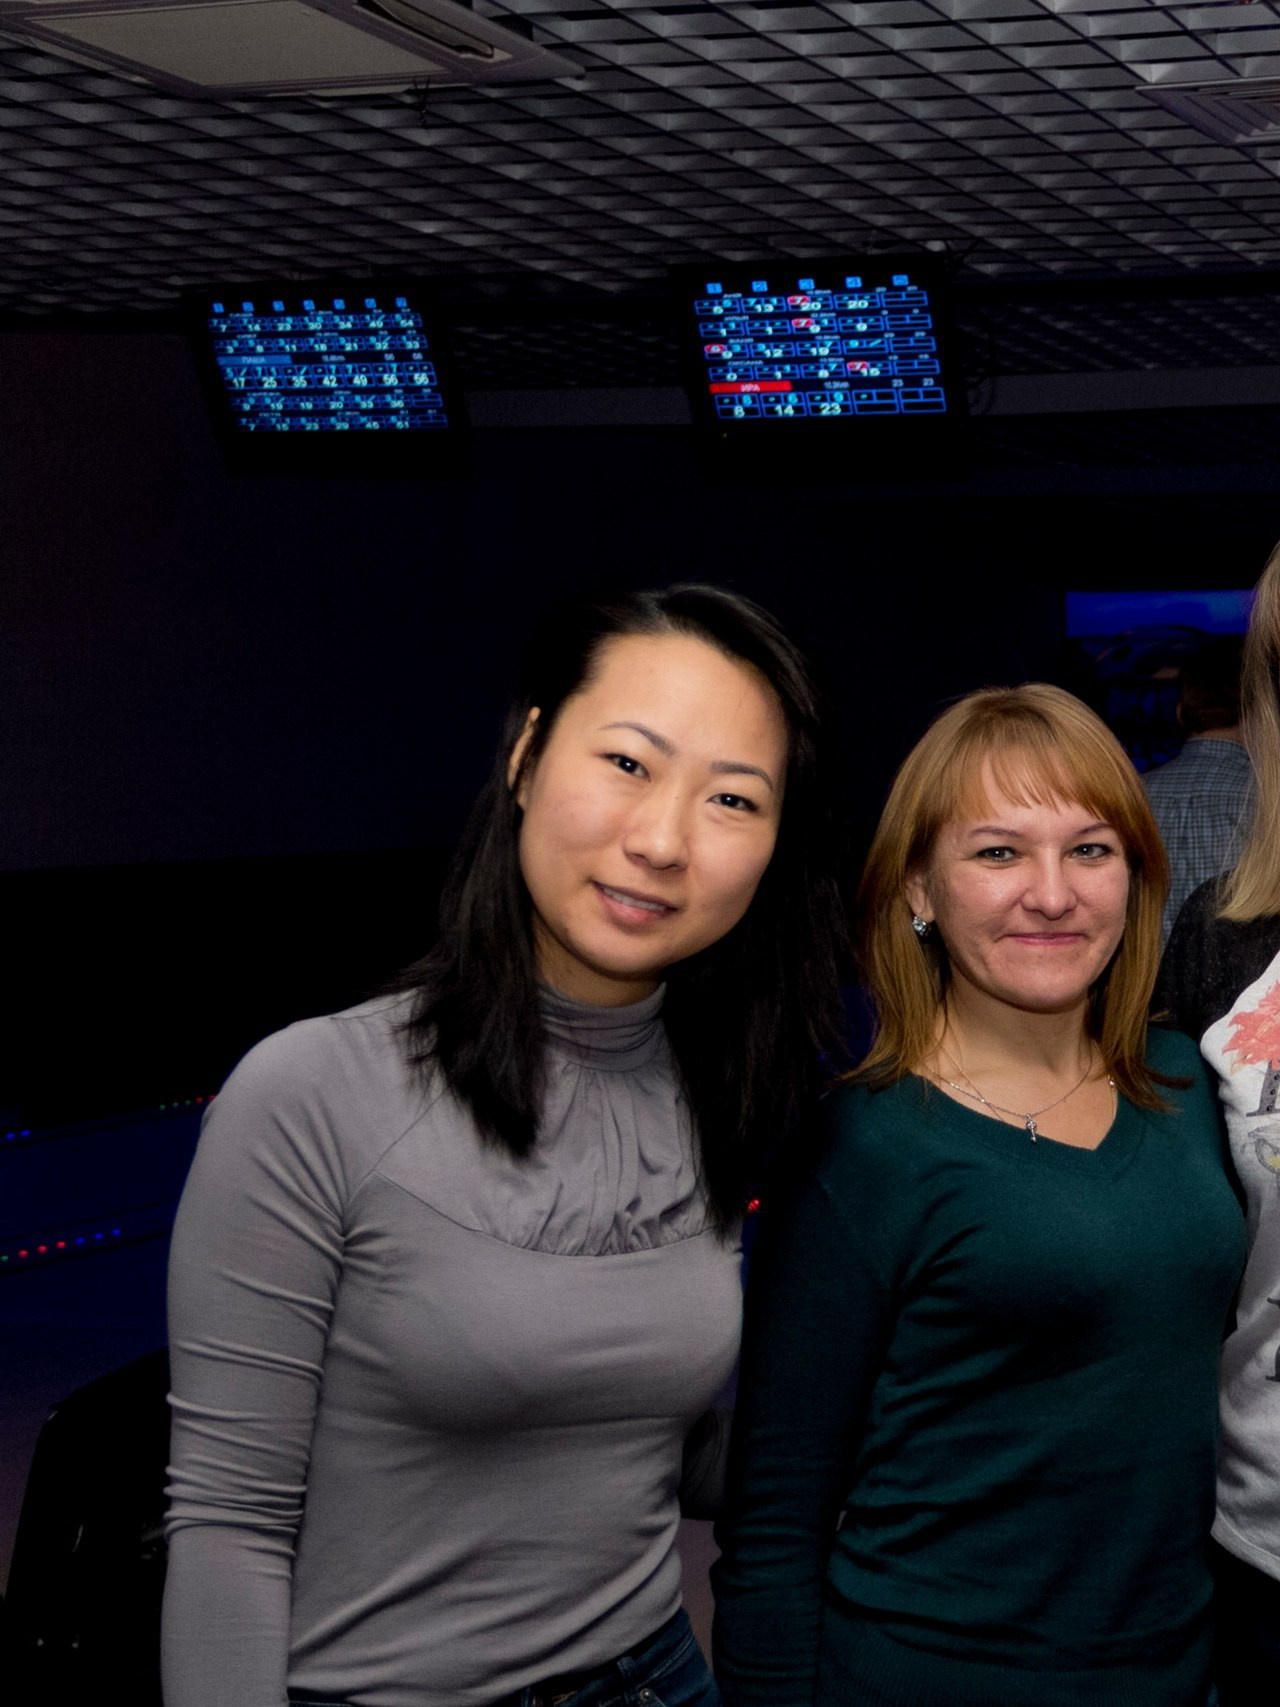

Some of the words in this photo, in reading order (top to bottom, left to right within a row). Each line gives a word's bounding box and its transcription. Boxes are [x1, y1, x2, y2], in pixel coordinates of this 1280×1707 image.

[801, 302, 822, 311] 20
[849, 301, 869, 309] 20
[233, 378, 245, 388] 17
[262, 377, 277, 388] 25
[292, 376, 307, 388] 35
[322, 376, 338, 387] 42
[353, 375, 368, 386] 49
[383, 374, 399, 385] 56
[413, 373, 429, 385] 56
[741, 384, 760, 393] ИРА
[734, 406, 745, 417] 8
[776, 405, 794, 415] 14
[821, 403, 842, 415] 23
